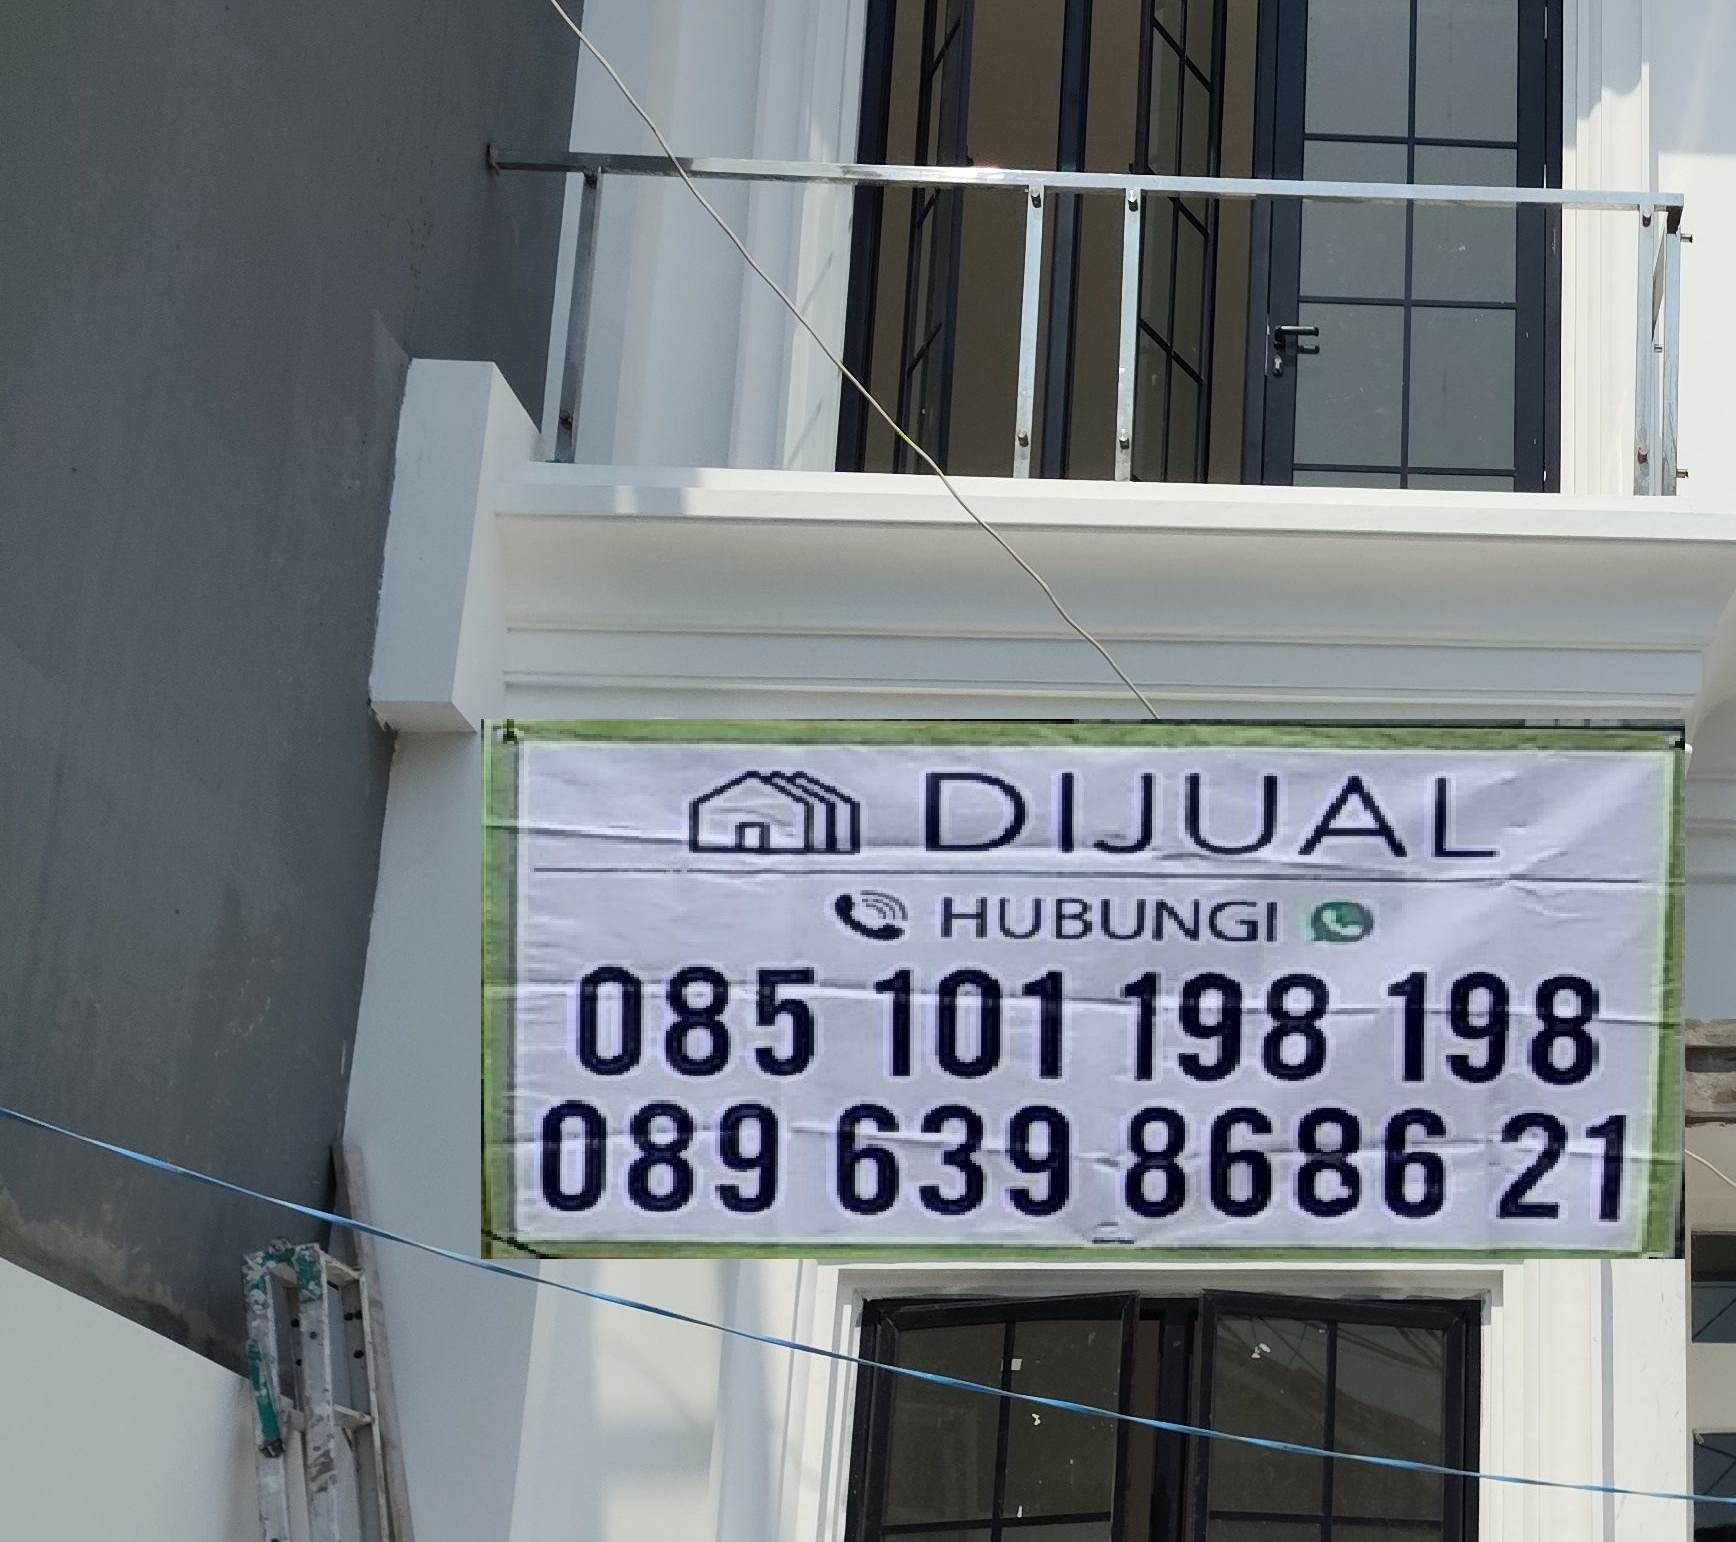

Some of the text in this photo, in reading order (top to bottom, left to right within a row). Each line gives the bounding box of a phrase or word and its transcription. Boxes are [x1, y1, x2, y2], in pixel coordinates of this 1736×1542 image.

[924, 771, 1497, 858] DIJUAL
[939, 895, 1279, 944] HUBUNGI
[578, 965, 1601, 1086] 085 101 198 198
[538, 1098, 1628, 1224] 089 639 8686 21
